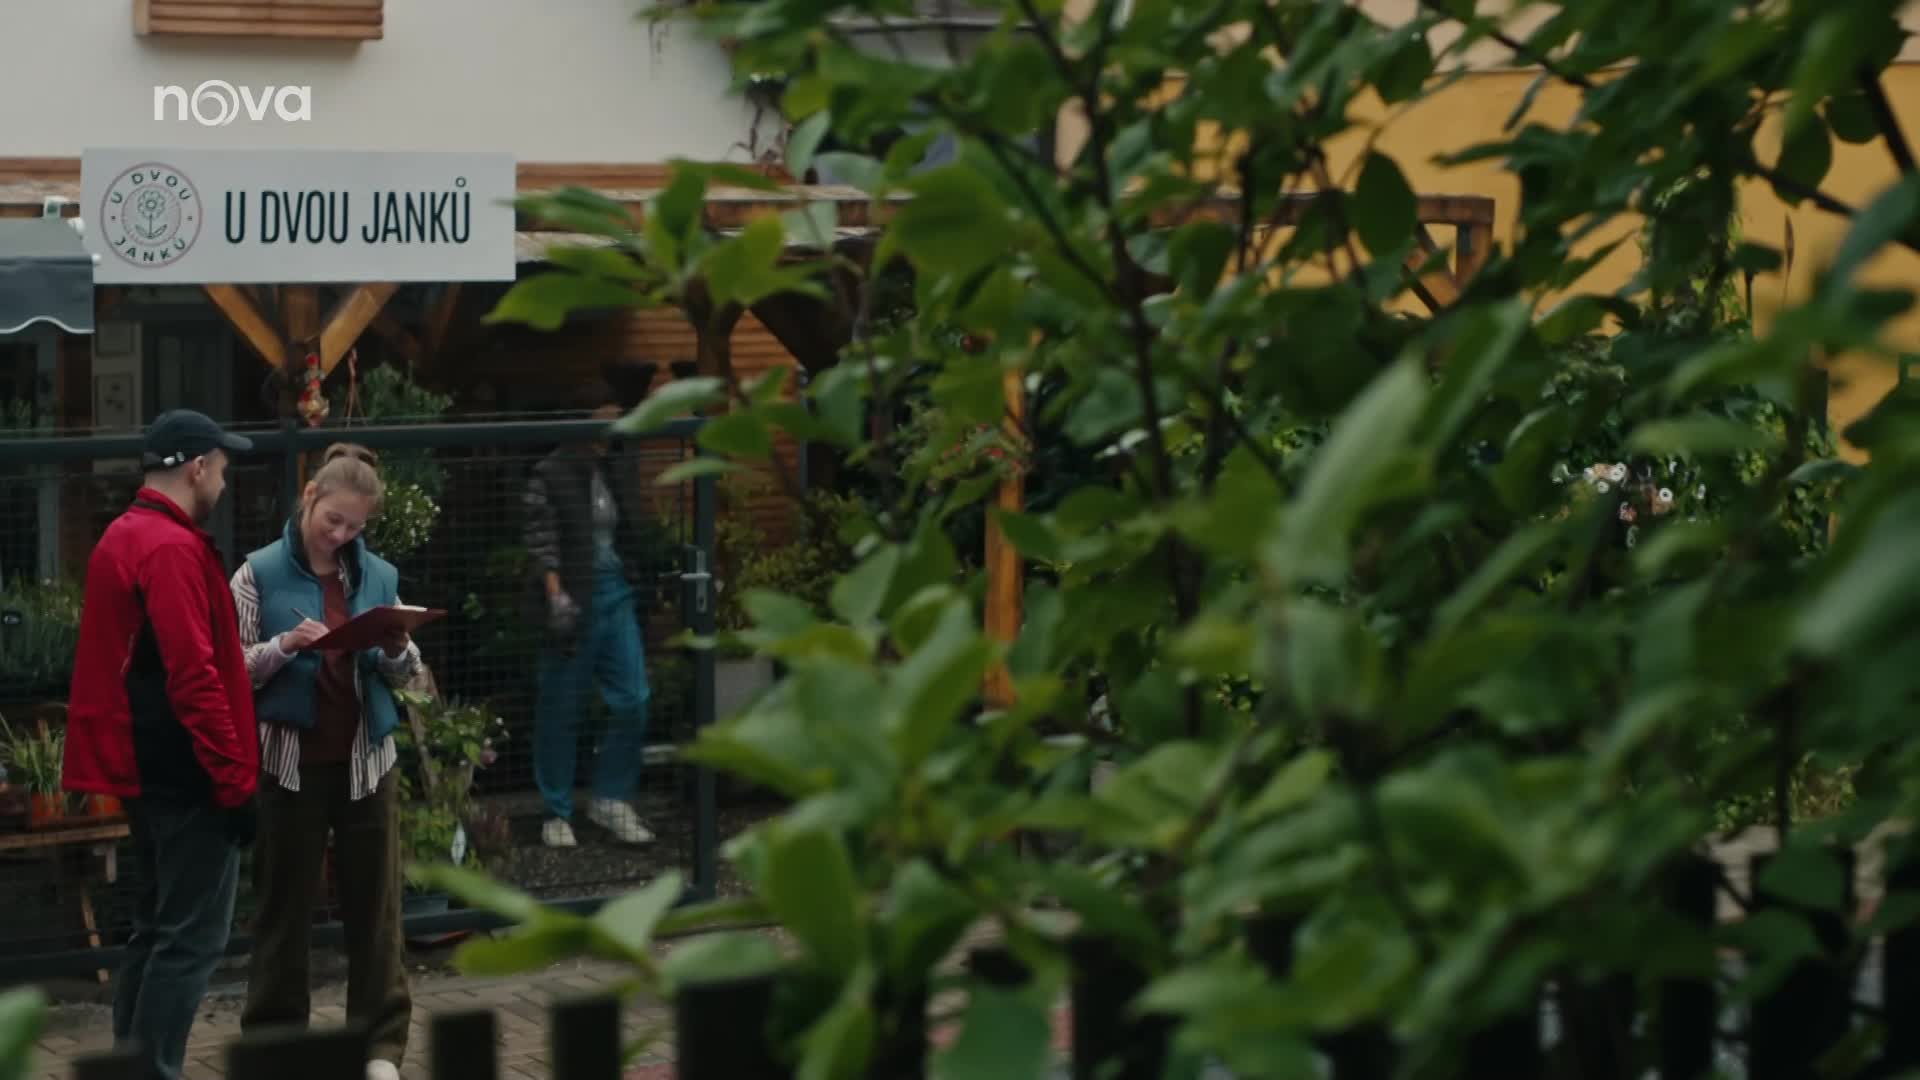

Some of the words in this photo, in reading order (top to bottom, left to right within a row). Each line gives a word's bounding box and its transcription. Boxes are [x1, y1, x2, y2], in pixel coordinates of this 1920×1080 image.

[111, 191, 123, 204] U
[131, 169, 192, 201] DVOU
[224, 190, 247, 244] U
[259, 190, 349, 244] DVOU
[361, 177, 471, 244] JANKŮ
